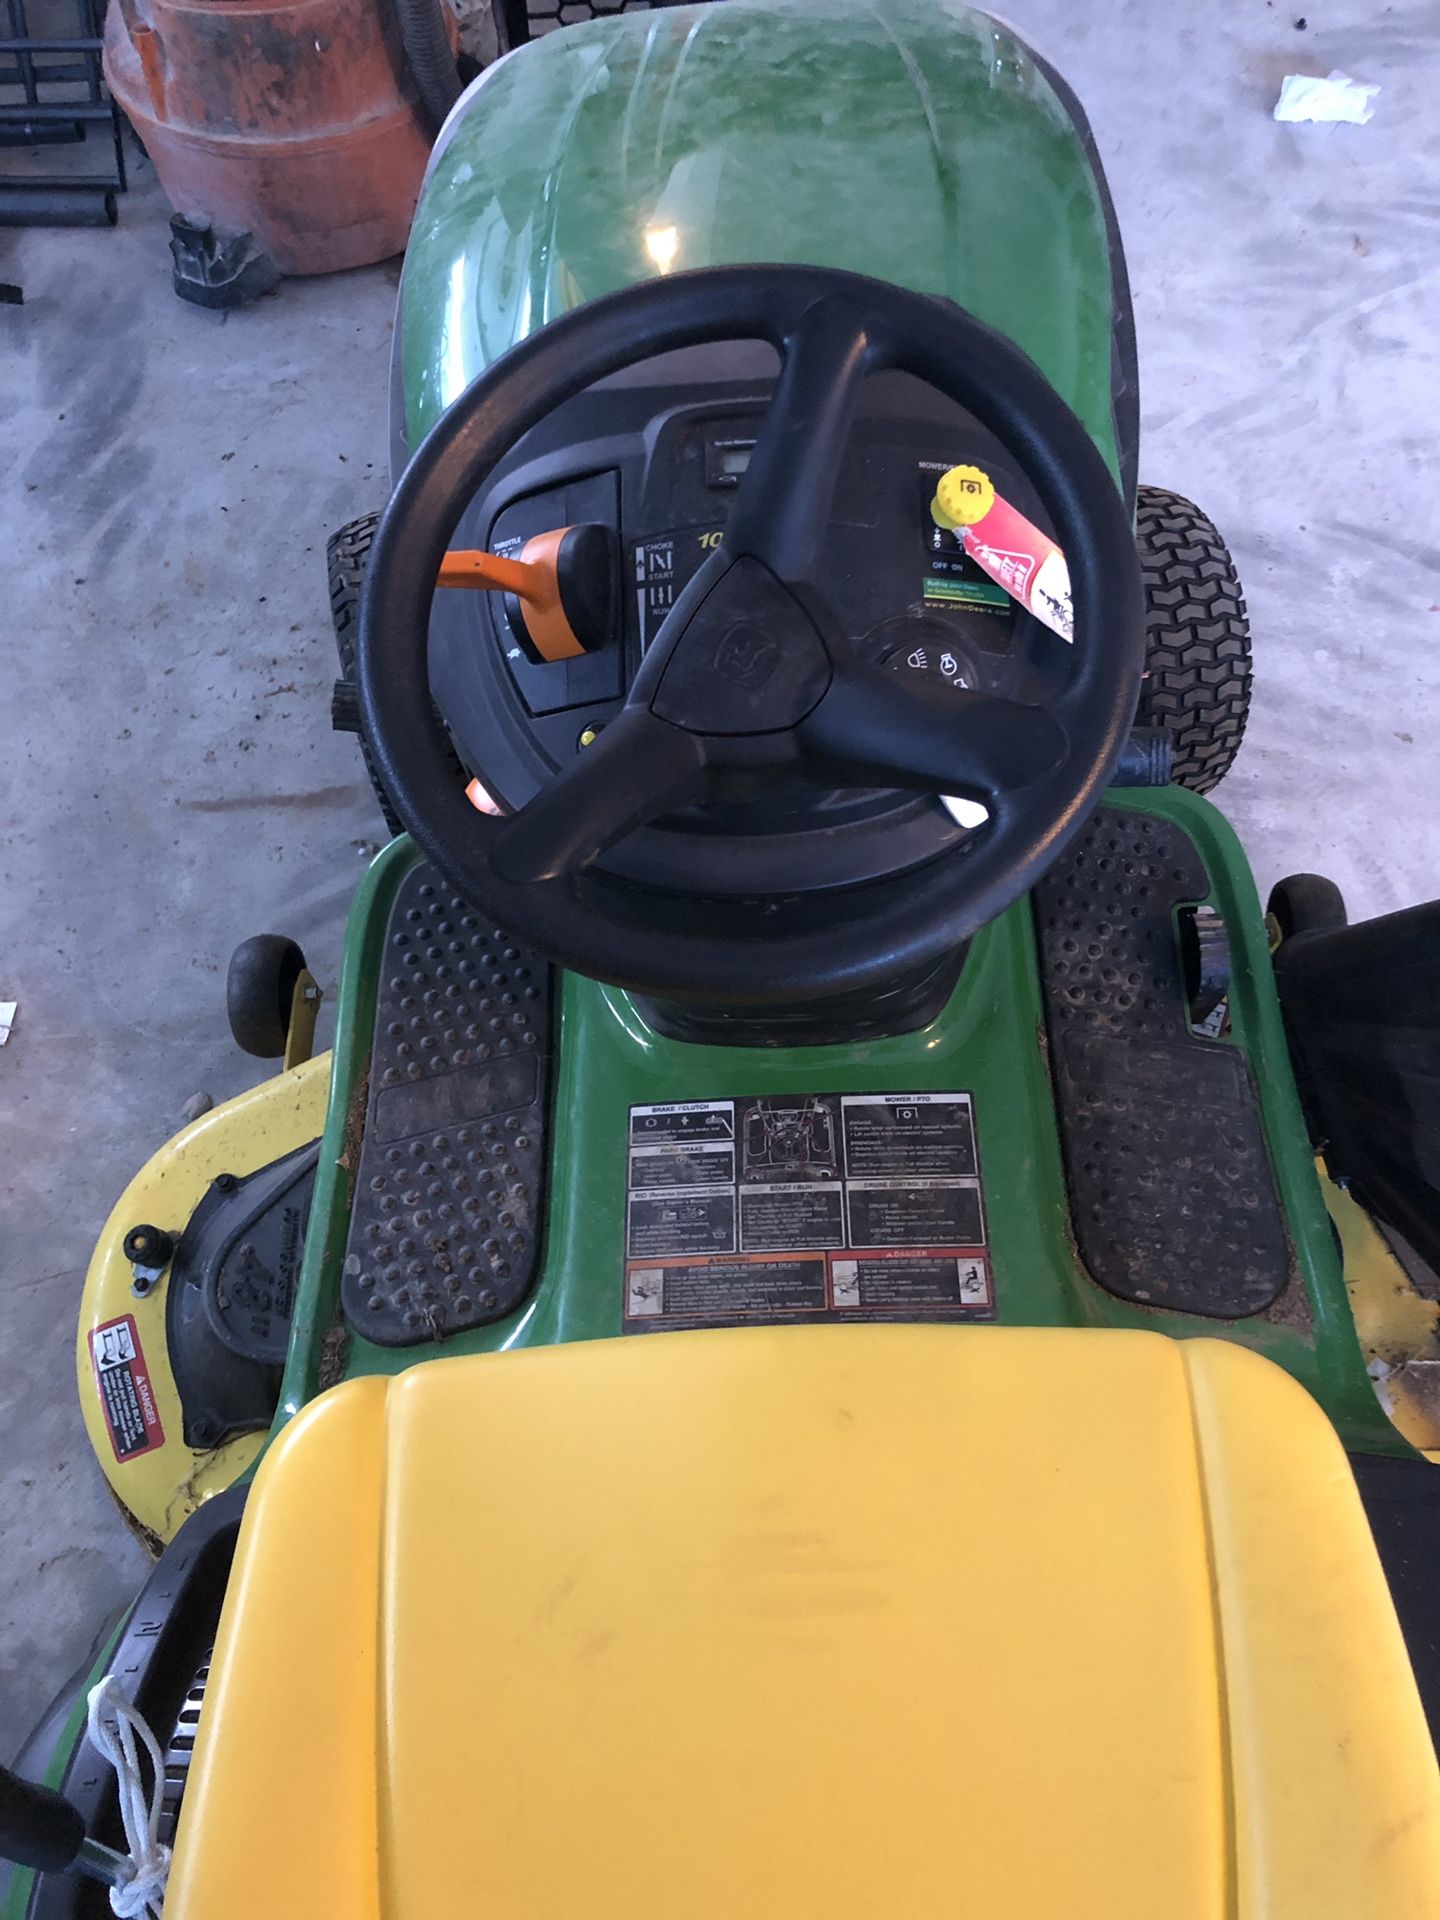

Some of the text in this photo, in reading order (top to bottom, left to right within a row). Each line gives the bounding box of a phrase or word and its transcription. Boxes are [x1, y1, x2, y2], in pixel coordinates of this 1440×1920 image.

[494, 536, 521, 550] THROTTLE
[645, 541, 674, 551] CHOKE
[932, 561, 963, 571] OFF ON
[648, 571, 674, 580] START
[652, 607, 671, 616] RUN
[652, 1105, 675, 1113] BRAKE
[114, 1368, 121, 1378] Do
[123, 1370, 144, 1434] ROTATING BLADE
[139, 1385, 157, 1425] DANGER
